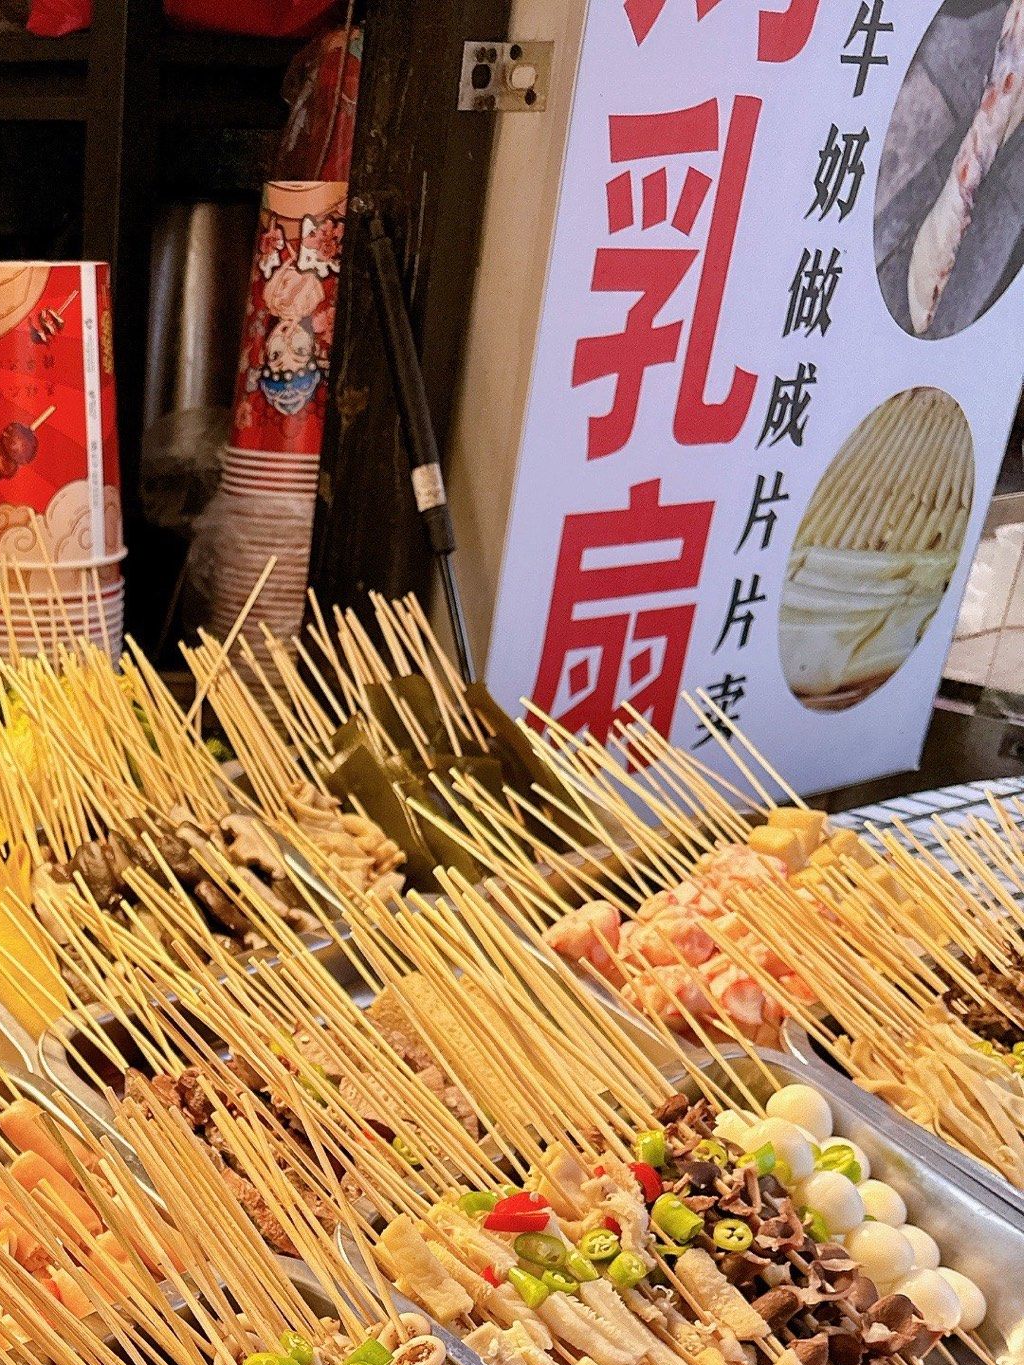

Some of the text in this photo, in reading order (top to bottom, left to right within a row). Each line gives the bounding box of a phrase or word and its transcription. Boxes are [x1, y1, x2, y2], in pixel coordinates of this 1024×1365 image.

[522, 0, 820, 776] 乳扇
[691, 0, 894, 750] 牛奶做成片片卖
